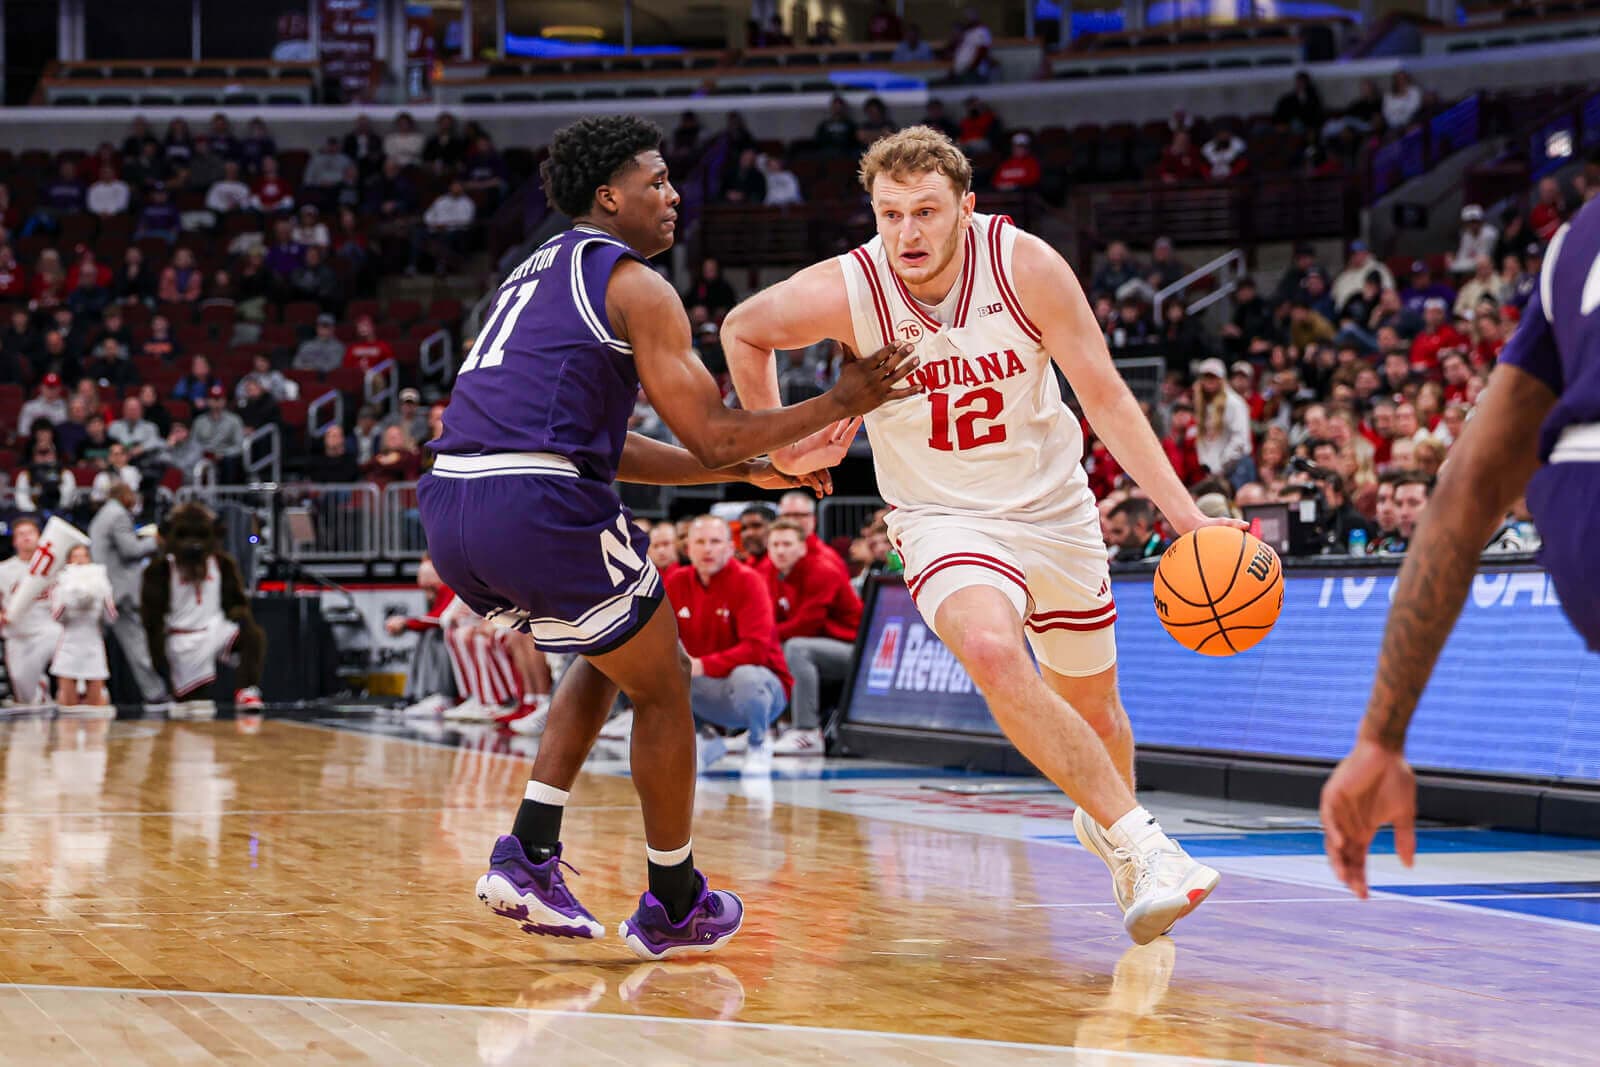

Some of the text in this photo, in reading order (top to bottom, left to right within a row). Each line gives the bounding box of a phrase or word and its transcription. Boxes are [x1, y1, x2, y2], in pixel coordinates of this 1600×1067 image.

[458, 279, 540, 375] 11
[927, 387, 1007, 451] 12
[600, 503, 645, 588] N
